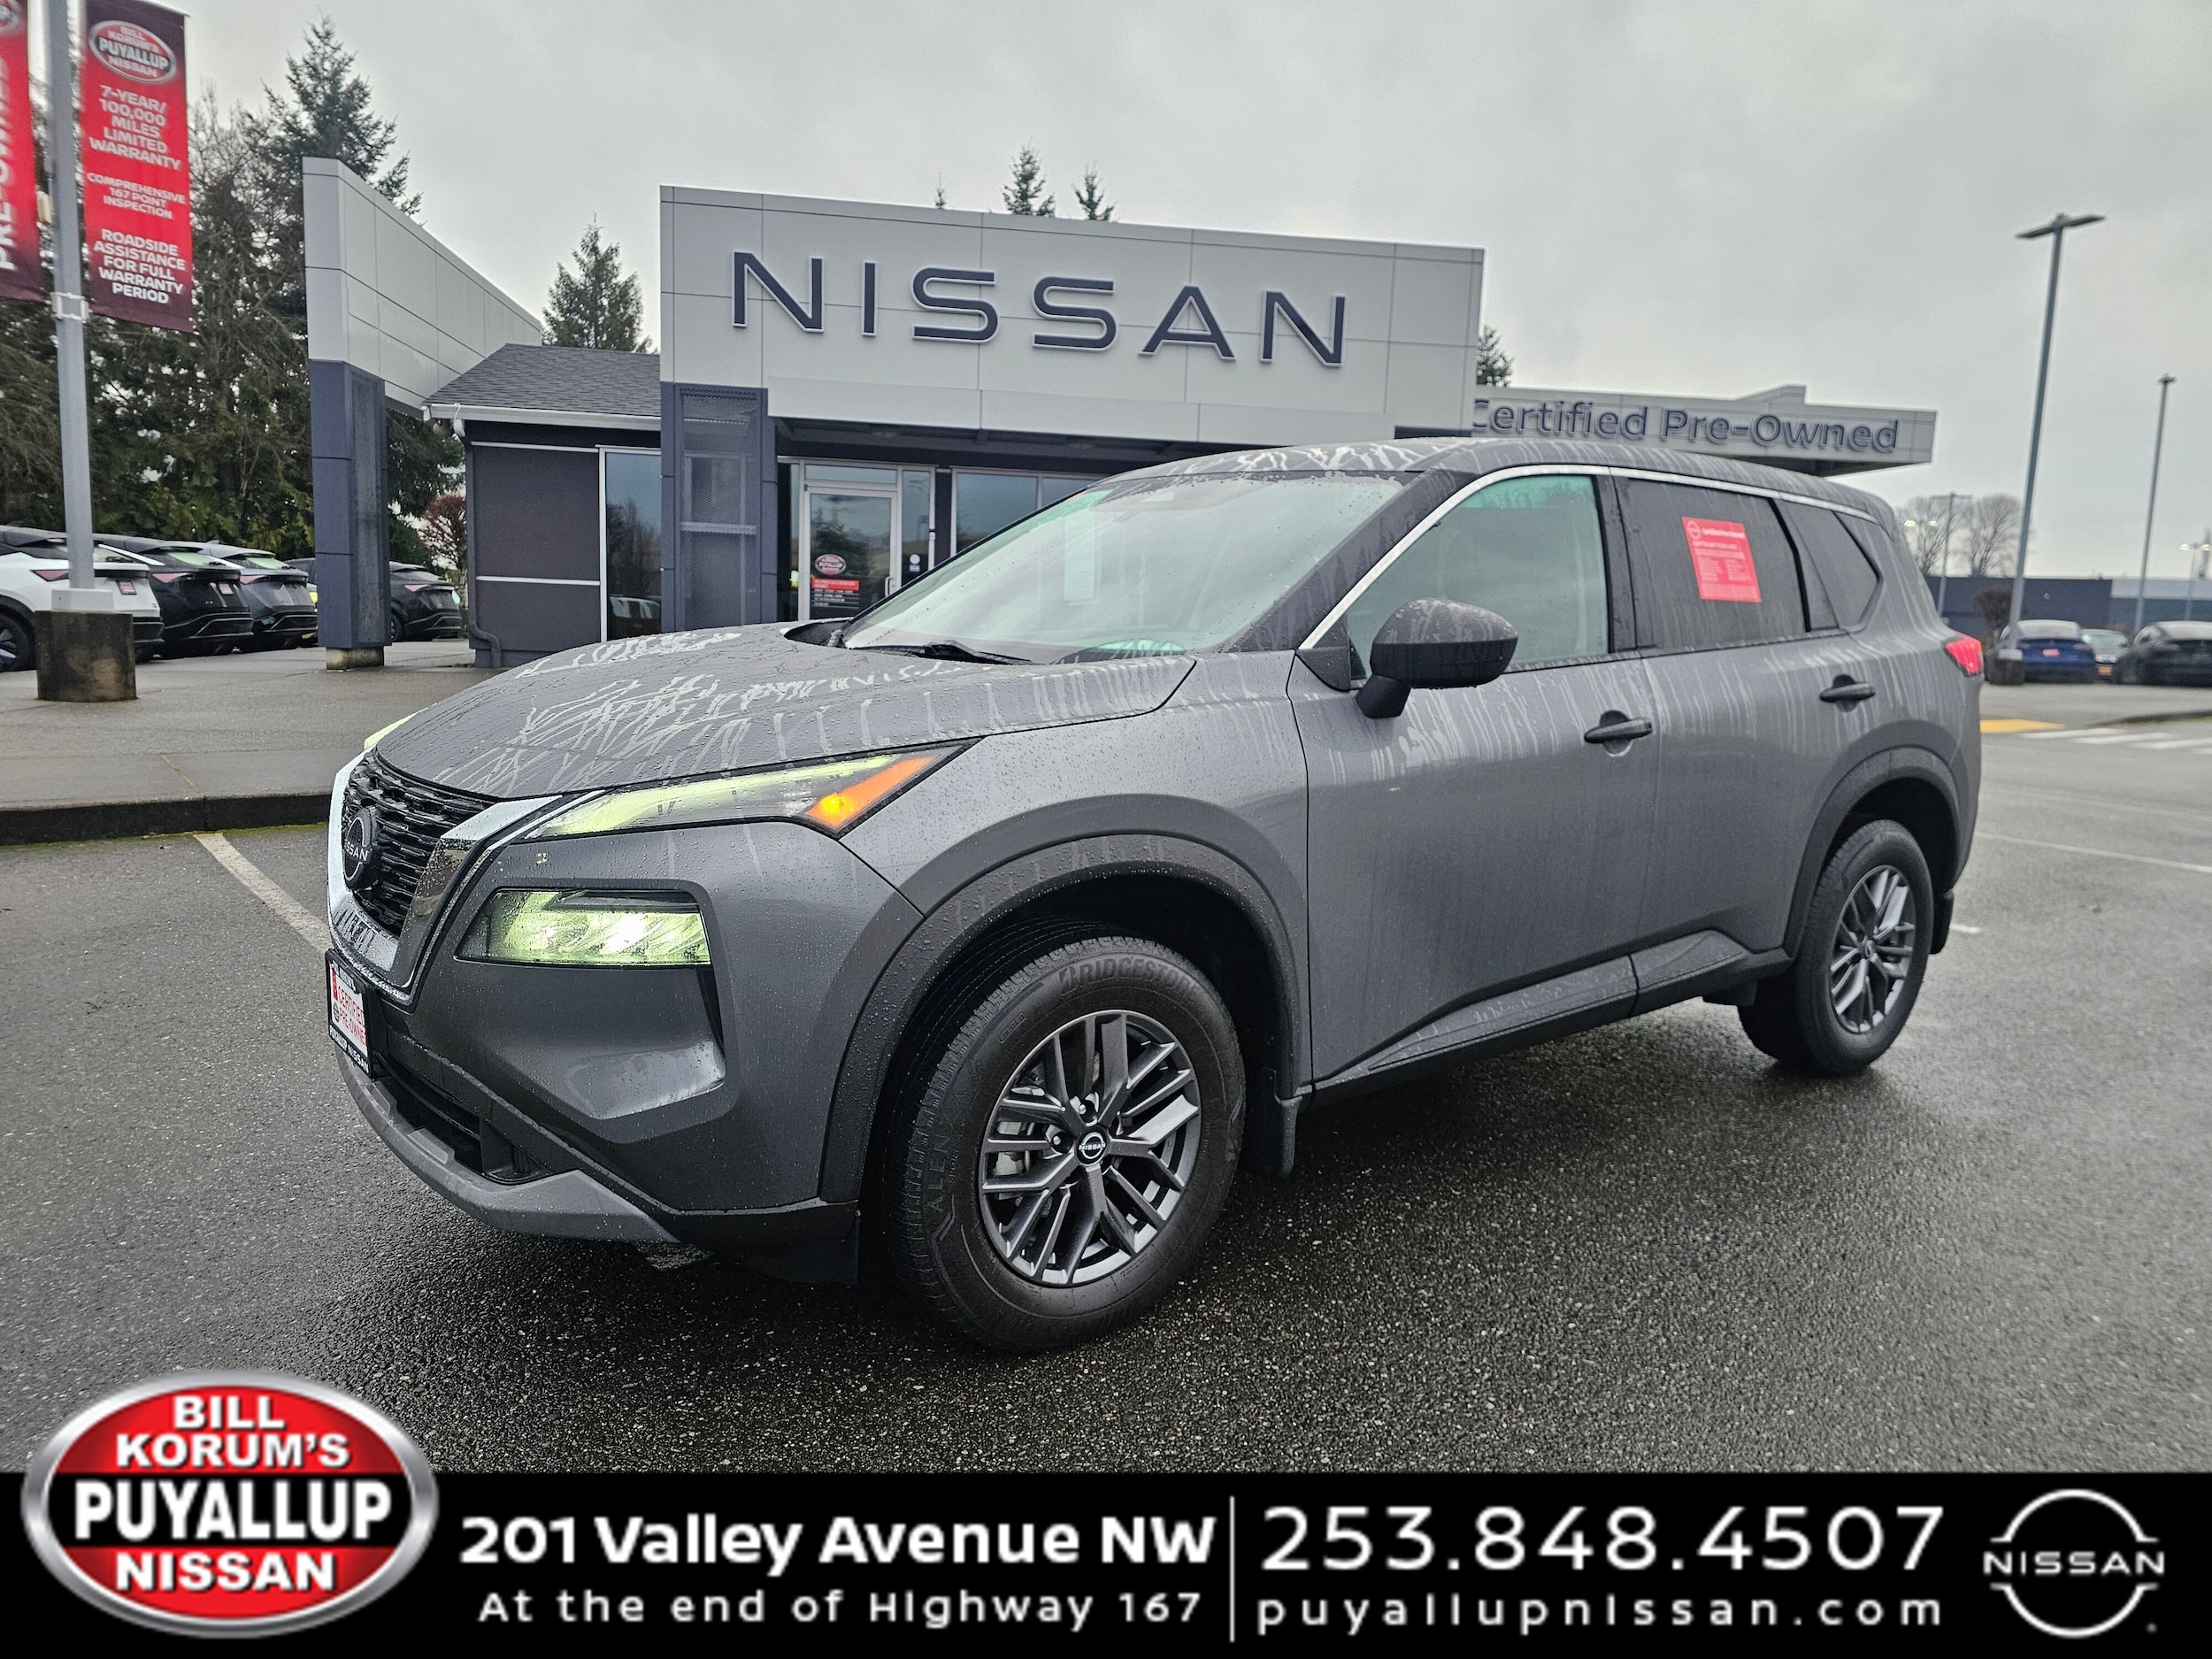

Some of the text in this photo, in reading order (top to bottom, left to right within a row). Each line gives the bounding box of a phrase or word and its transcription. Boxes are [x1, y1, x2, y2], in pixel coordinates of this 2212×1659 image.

[120, 26, 147, 40] BILL
[98, 37, 170, 70] PUYALLUP
[108, 56, 157, 78] NISSAN
[99, 98, 166, 127] 100,000
[100, 85, 167, 113] 7-YEAR/
[104, 127, 167, 153] LIMITED
[111, 116, 160, 138] MILES
[88, 137, 181, 171] WARRANTY
[87, 173, 186, 204] COMPREHENSIVE
[109, 187, 167, 207] 167 POINT
[104, 196, 172, 219] INSPECTION
[94, 241, 186, 270] ASSISTANCE
[101, 228, 178, 256] ROADSIDE
[98, 267, 184, 295] WARRANTY
[104, 256, 175, 280] FOR FULL
[112, 282, 169, 303] PERIOD
[732, 251, 1347, 366] NISSAN
[1662, 408, 1899, 451] Pre-Owned
[348, 1044, 369, 1073] NISSAN
[1079, 1141, 1106, 1151] NISSAN
